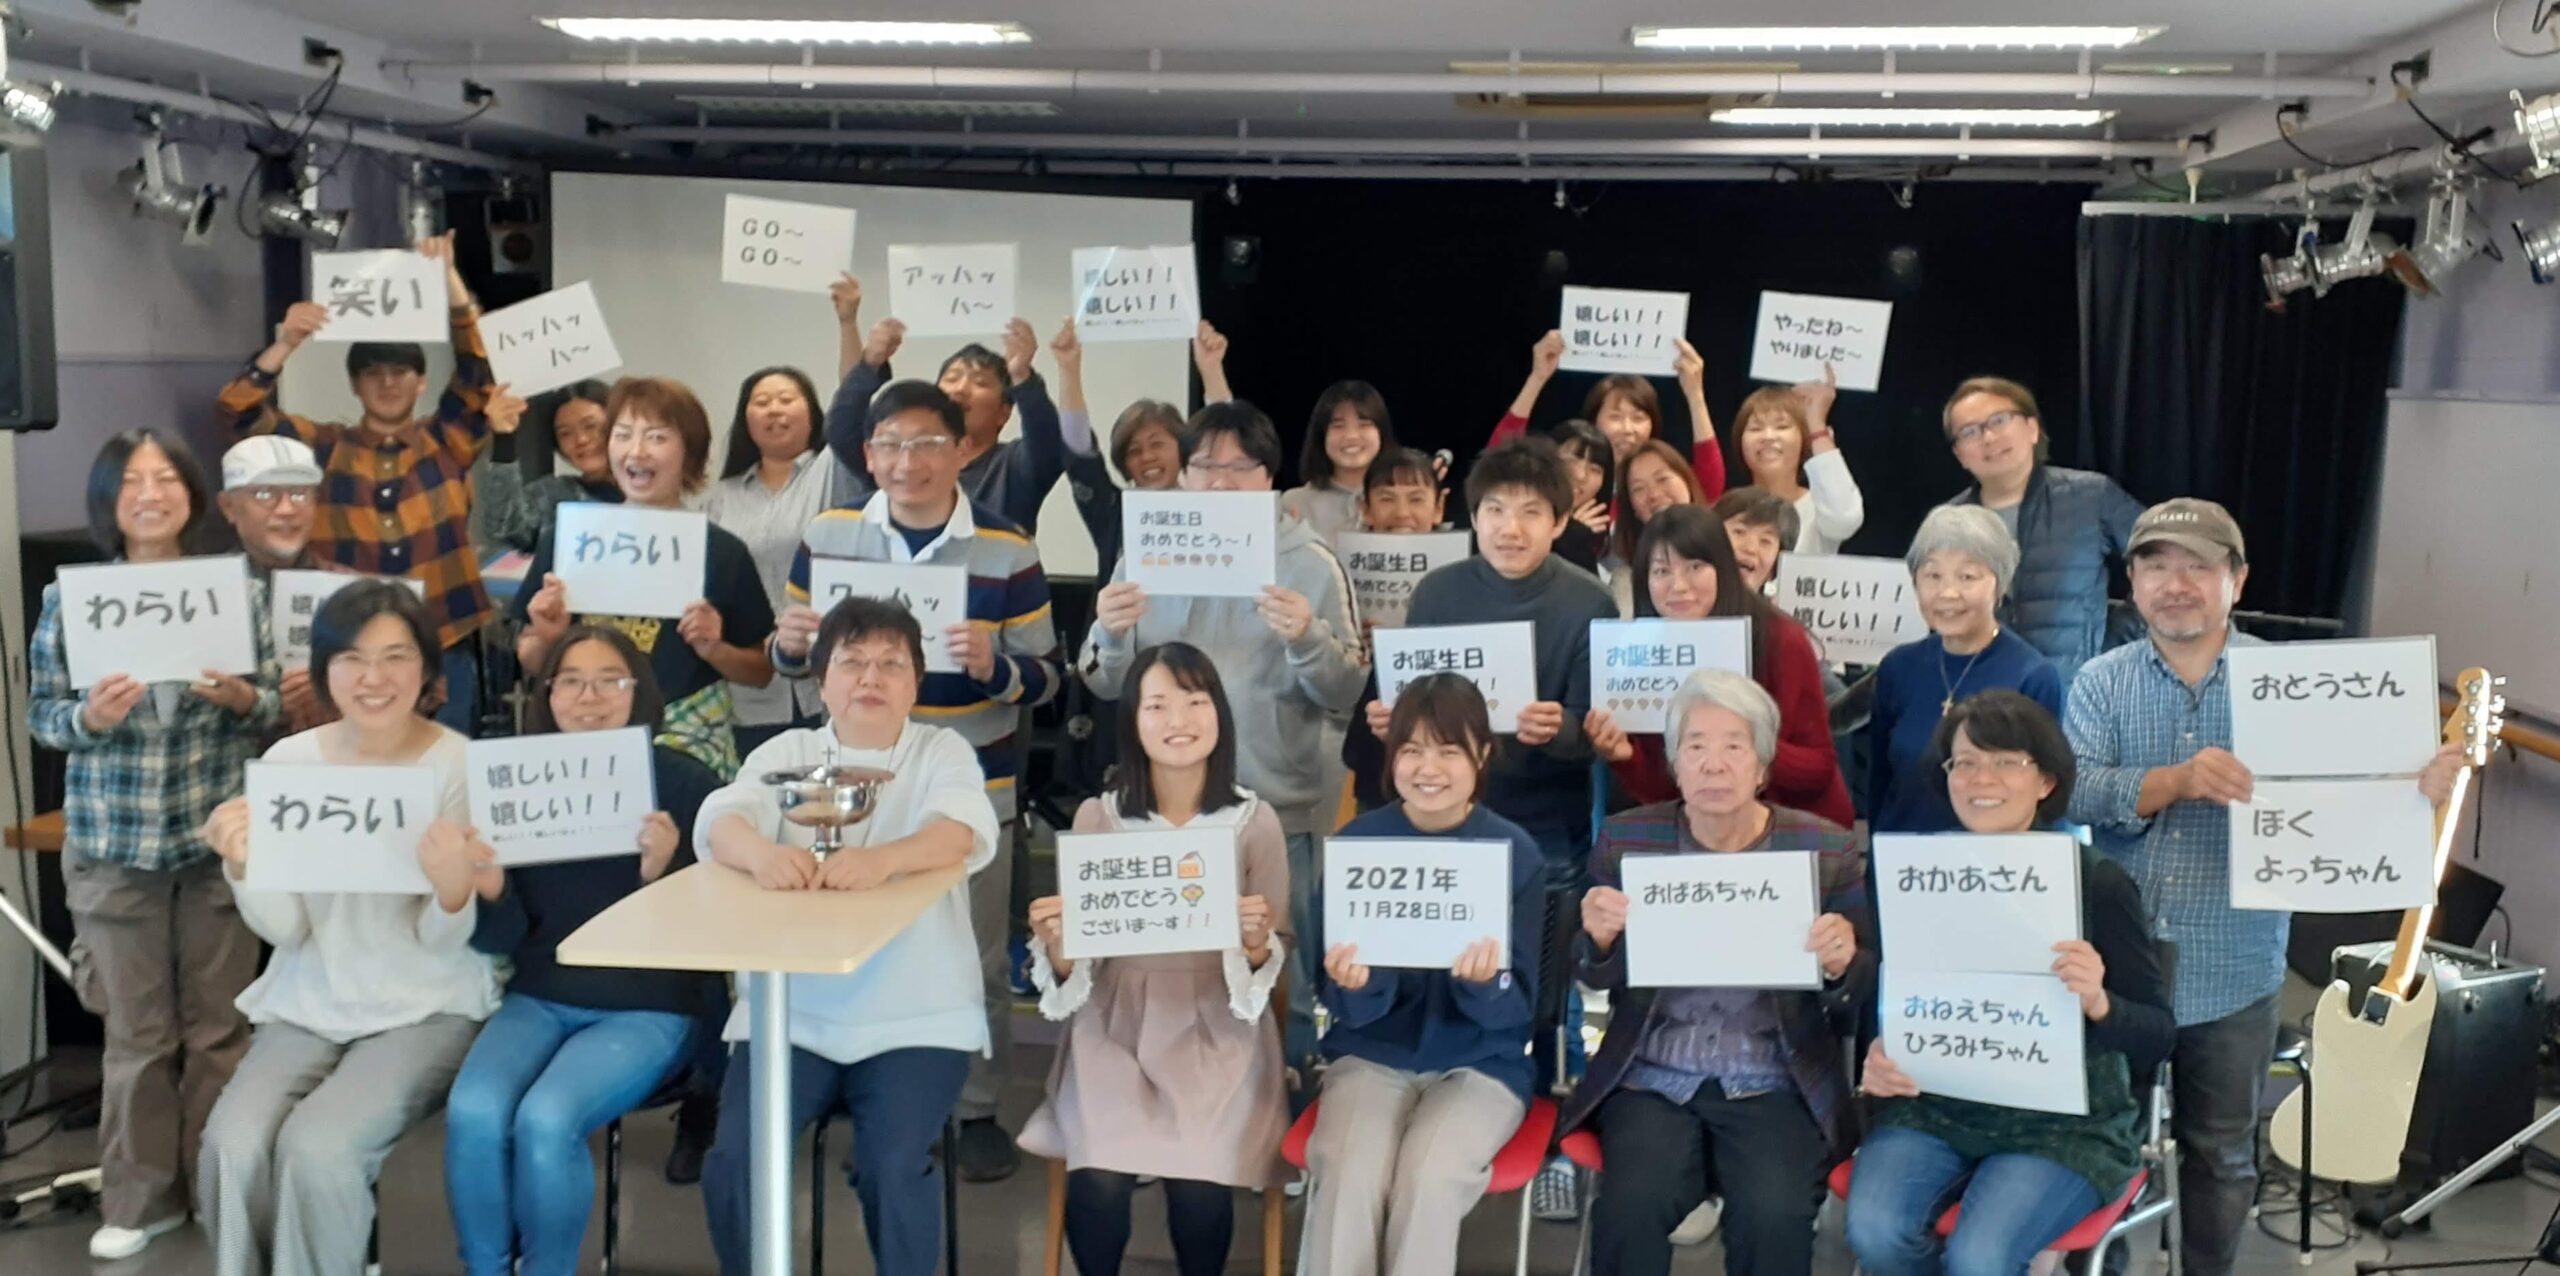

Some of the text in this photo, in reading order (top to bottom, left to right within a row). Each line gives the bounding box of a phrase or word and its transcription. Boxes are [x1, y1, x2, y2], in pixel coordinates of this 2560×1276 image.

[329, 274, 423, 318] 笑い
[1140, 510, 1203, 527] お誕生日
[574, 530, 681, 565] わらい
[1349, 552, 1428, 573] お誕生日
[85, 587, 220, 631] わらい
[1392, 646, 1485, 672] お誕生日
[1606, 643, 1696, 668] お誕生日
[2252, 670, 2406, 701] おとうさん
[269, 793, 405, 835] わらい
[1078, 855, 1173, 882] お誕生日
[1345, 866, 1459, 893] 2021年
[1897, 864, 2049, 893] おかあさん
[2254, 854, 2402, 885] よっちゃん
[1080, 886, 1178, 912] おめでとう
[1643, 879, 1780, 905] おばあちゃん
[1903, 994, 2051, 1028] おねえちゃん
[1903, 1031, 2049, 1064] ひろみちゃん
